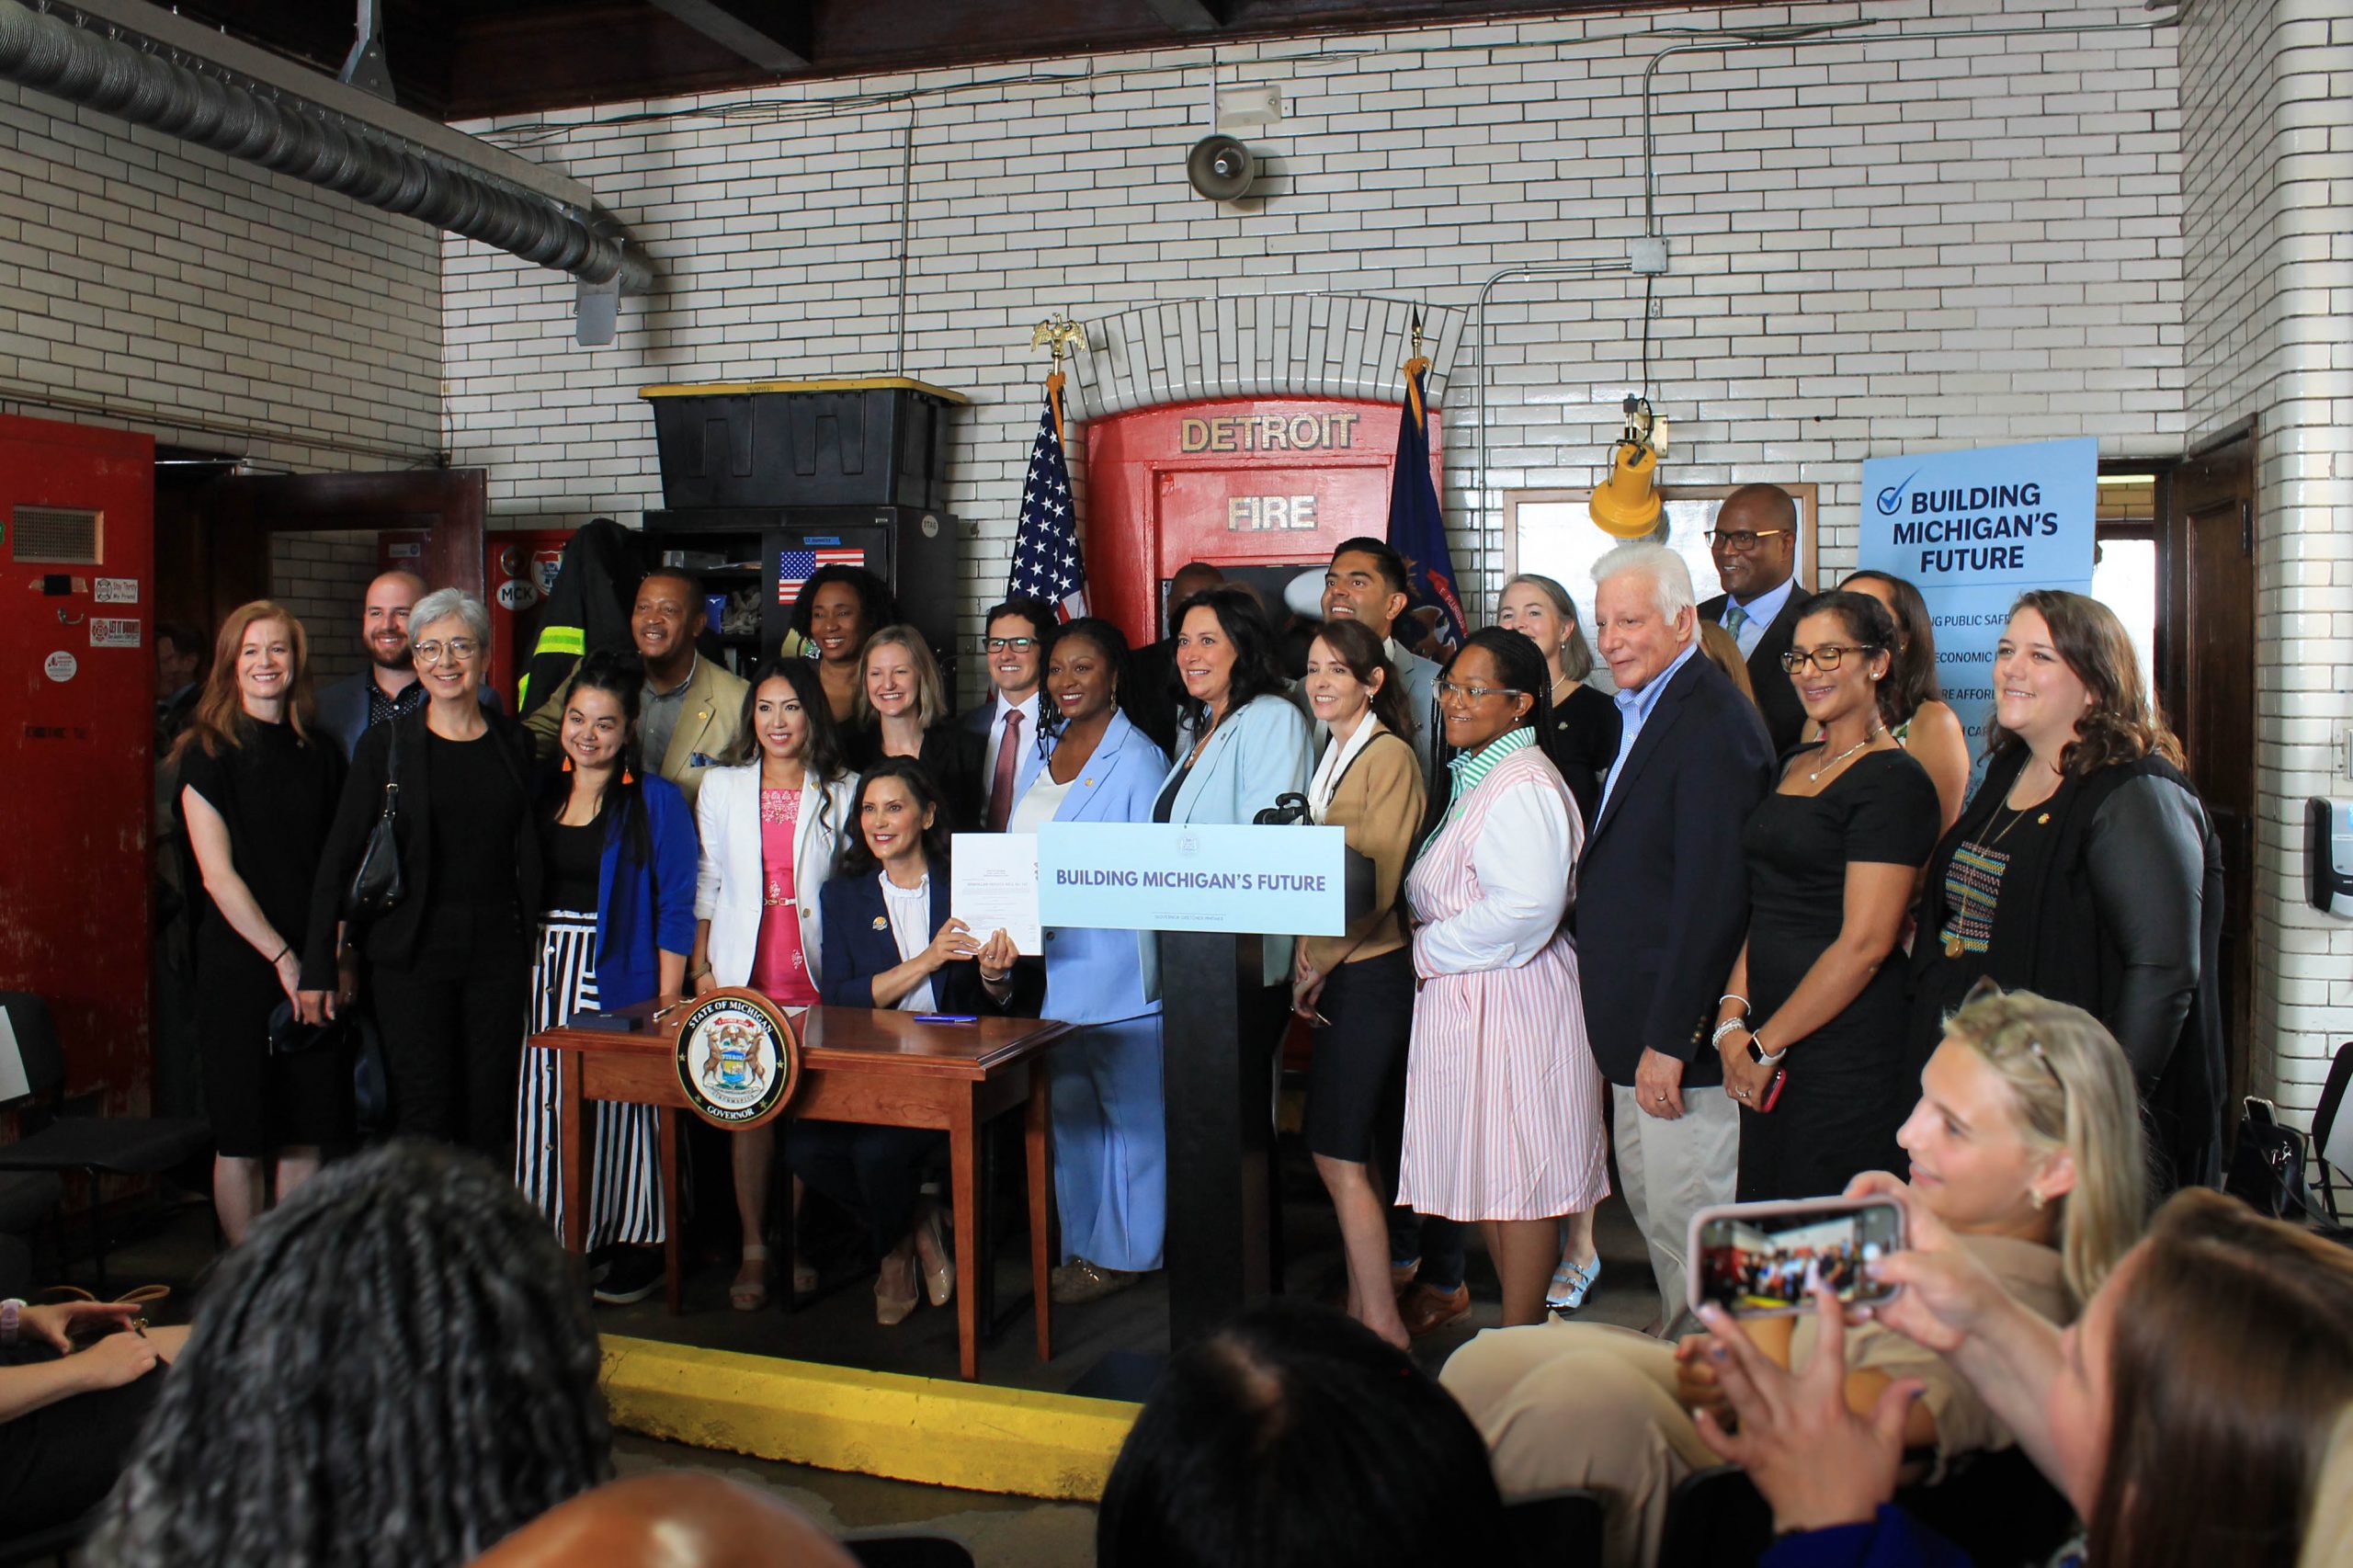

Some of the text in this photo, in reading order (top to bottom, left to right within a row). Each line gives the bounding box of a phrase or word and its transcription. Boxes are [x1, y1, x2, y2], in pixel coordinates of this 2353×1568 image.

[1181, 413, 1359, 452] DETROIT
[1228, 494, 1317, 530] FIRE
[1912, 483, 2040, 514] BUILDING
[1893, 512, 2058, 544] MICHIGAN'S
[1920, 546, 2024, 573] FUTURE
[502, 587, 533, 601] MCK
[1944, 615, 1983, 627] PUBLIC
[1984, 614, 2010, 626] SAFE
[1935, 652, 1993, 663] ECONOMIC
[1057, 869, 1325, 892] BUILDING MICHIGAN'S FUTURE
[688, 1001, 774, 1034] STATE OF MICHIGAN
[707, 1105, 754, 1120] GOVERNOR
